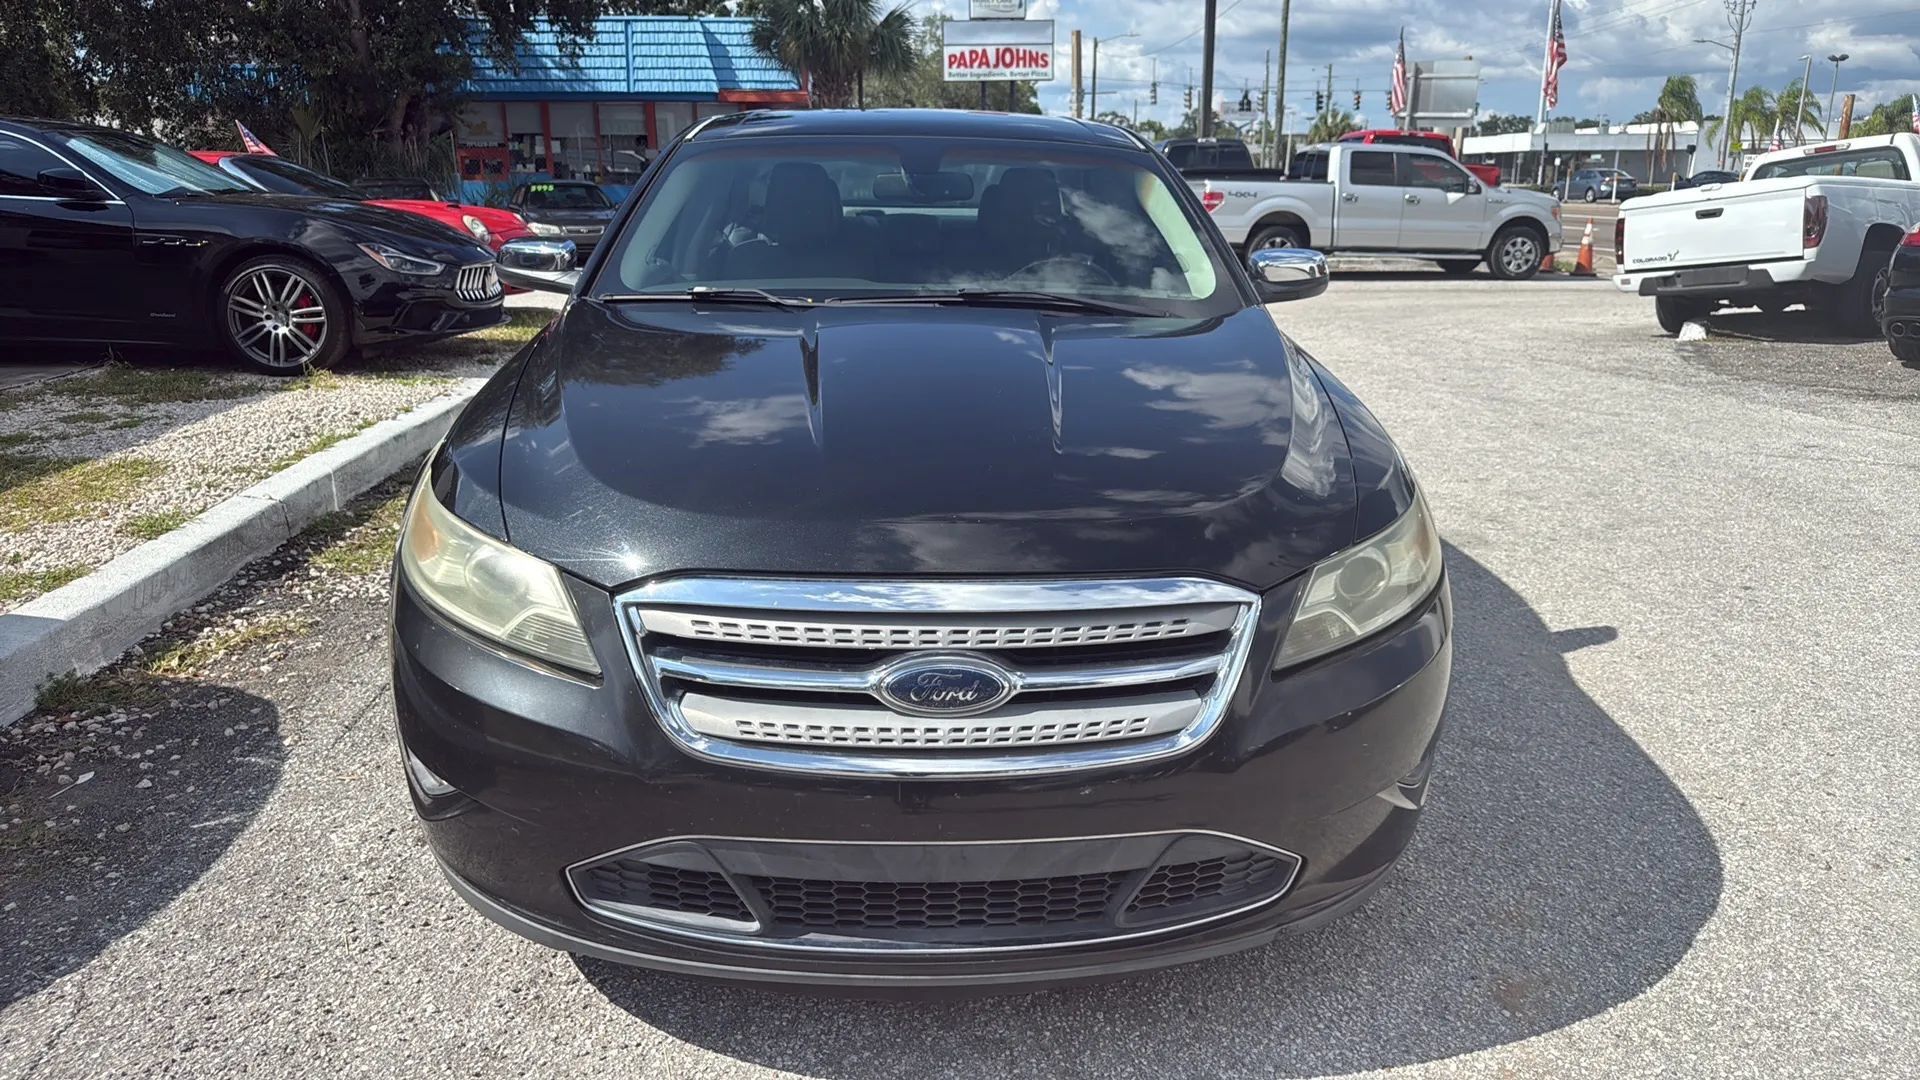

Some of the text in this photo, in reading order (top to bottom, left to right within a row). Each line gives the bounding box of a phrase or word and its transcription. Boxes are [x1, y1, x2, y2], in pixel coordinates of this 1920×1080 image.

[948, 47, 1049, 69] PAPA JOHNS
[910, 672, 980, 702] Ford
